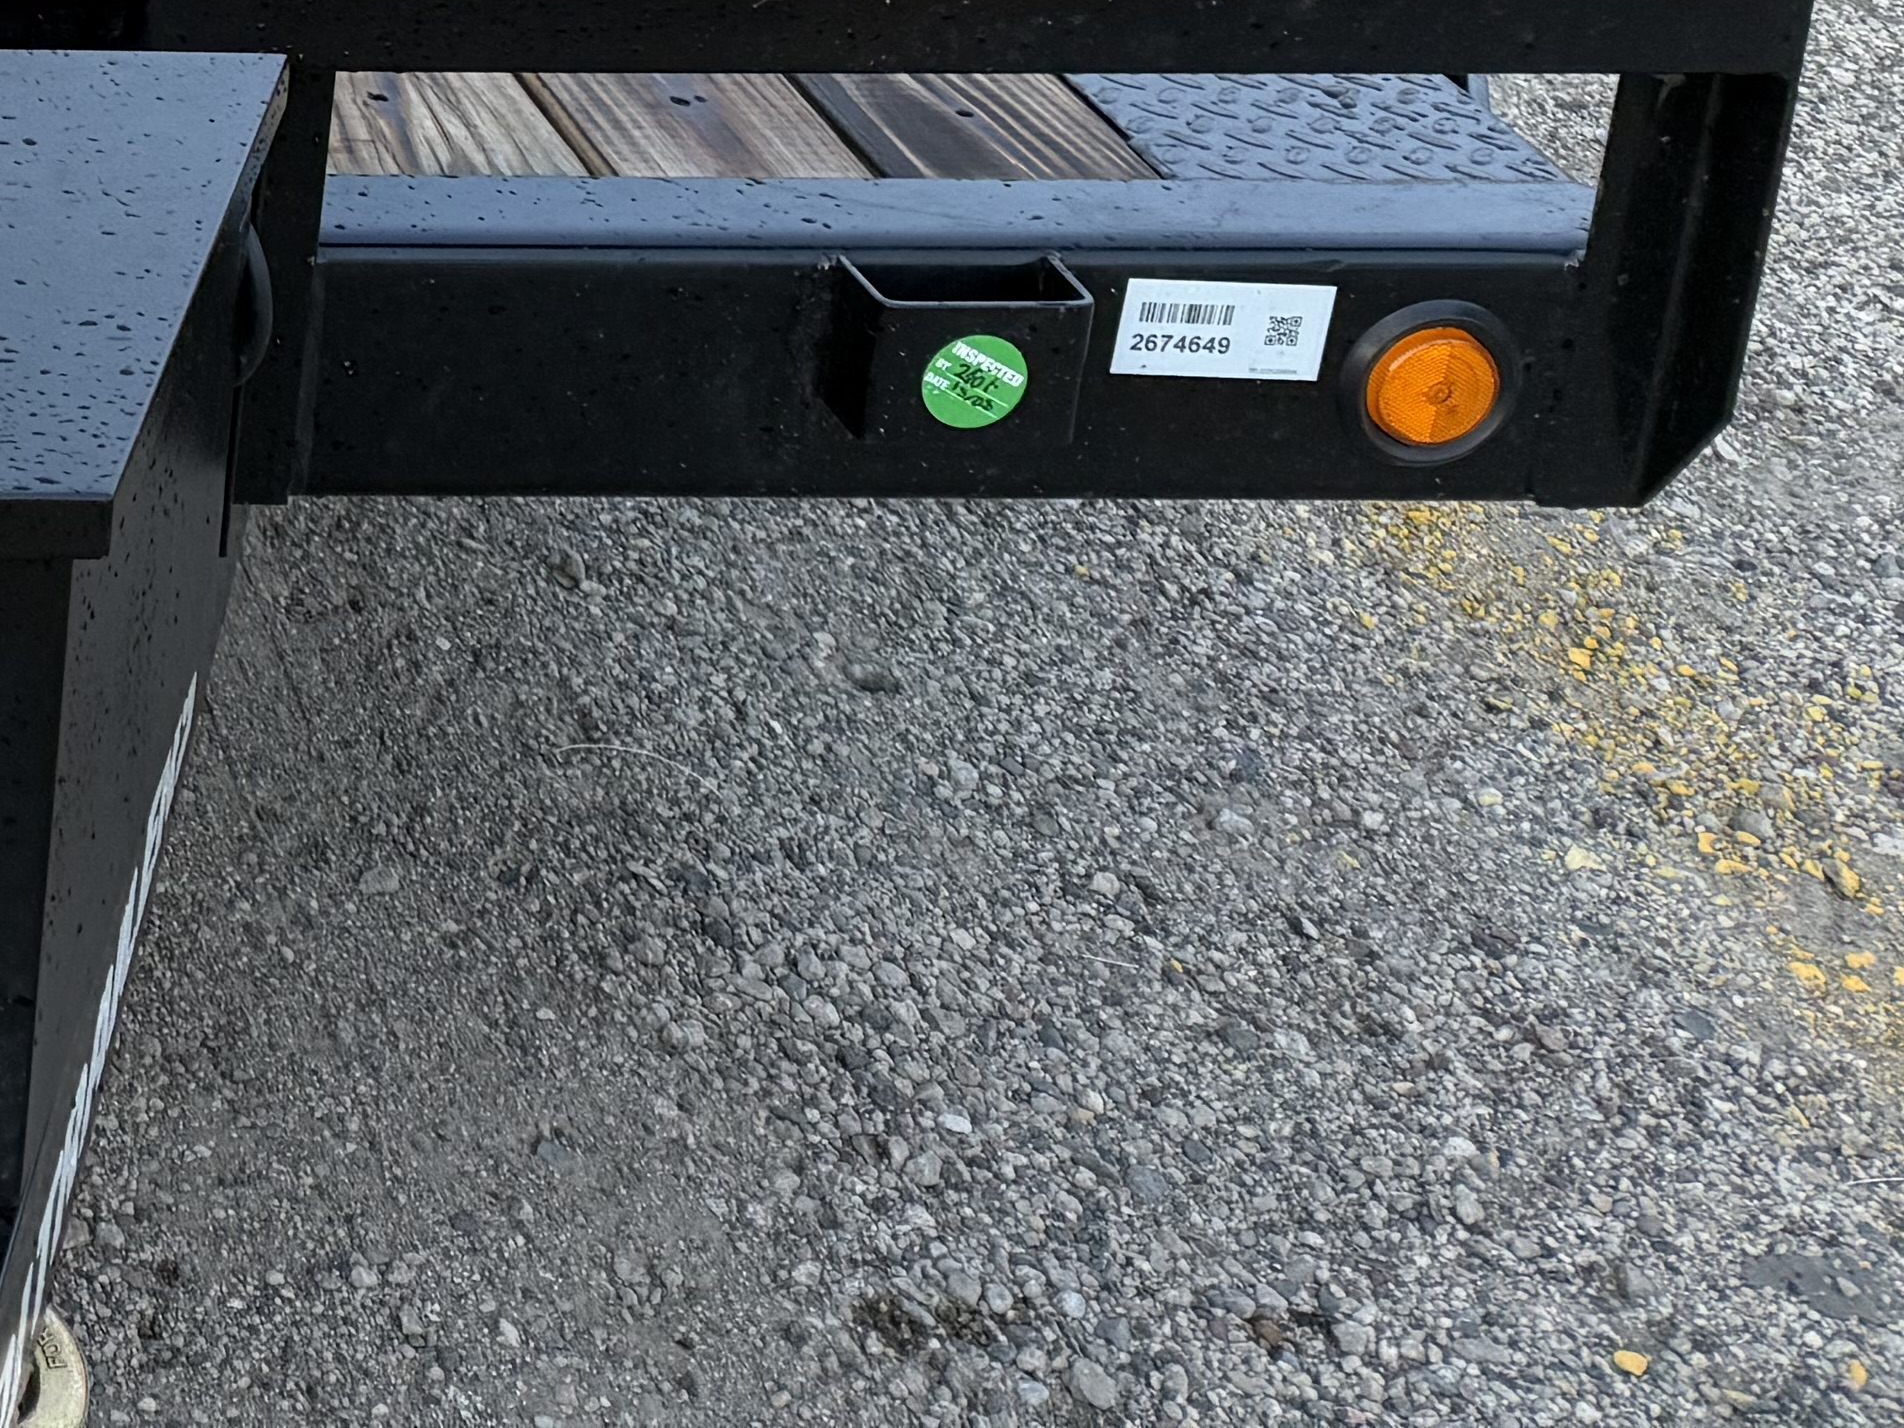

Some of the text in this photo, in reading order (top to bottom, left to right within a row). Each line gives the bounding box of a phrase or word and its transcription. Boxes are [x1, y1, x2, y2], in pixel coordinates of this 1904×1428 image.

[1130, 333, 1231, 355] 2674649
[934, 357, 952, 372] BY
[951, 341, 1025, 387] INSPECTED
[922, 371, 950, 391] DATE
